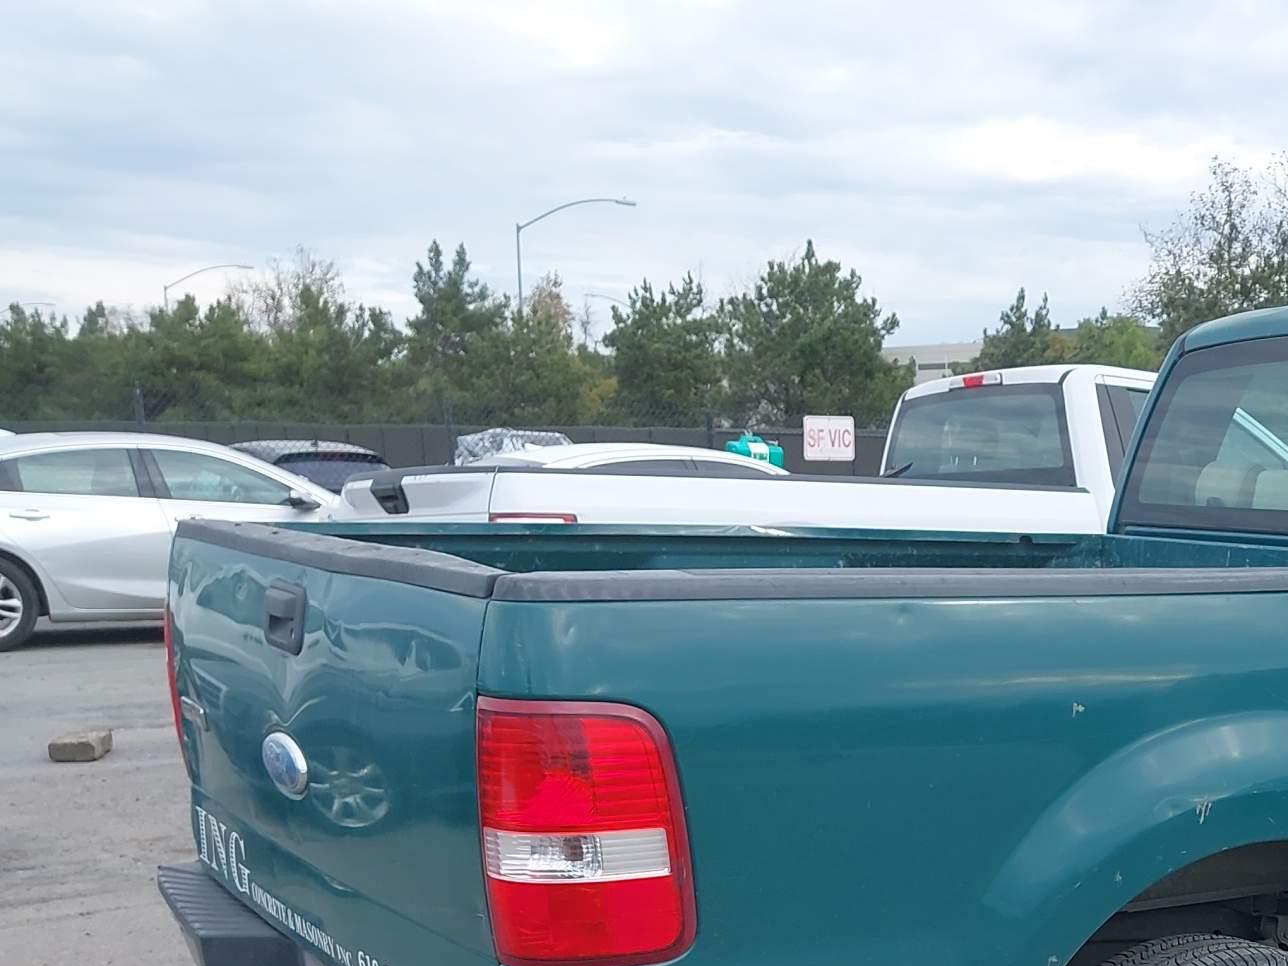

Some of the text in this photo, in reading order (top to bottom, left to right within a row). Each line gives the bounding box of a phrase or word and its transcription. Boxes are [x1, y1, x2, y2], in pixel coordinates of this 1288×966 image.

[807, 428, 852, 448] SF VIC
[293, 912, 336, 958] MASONRY
